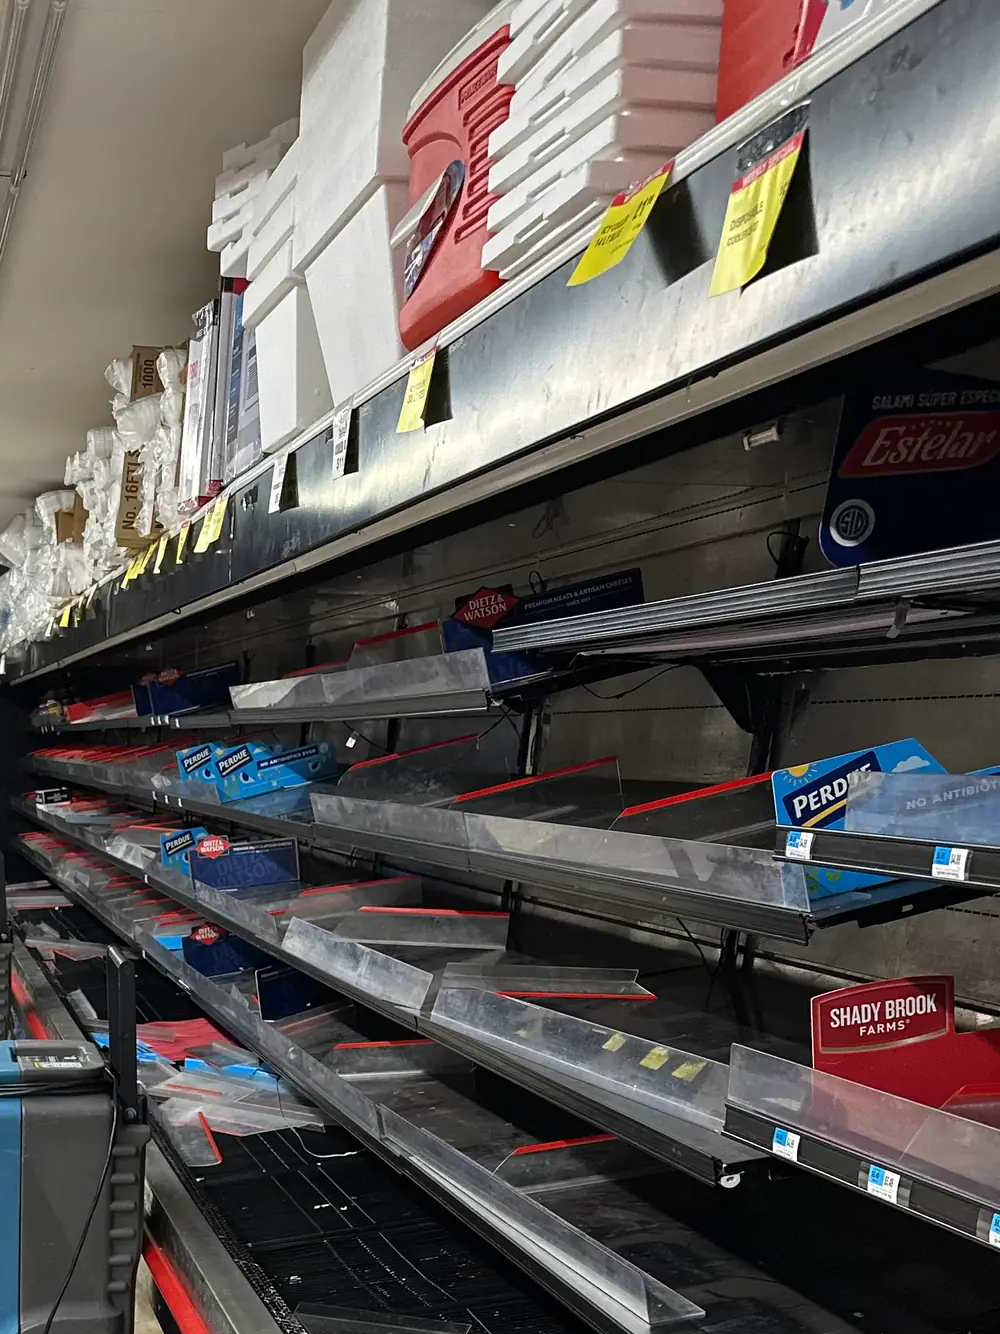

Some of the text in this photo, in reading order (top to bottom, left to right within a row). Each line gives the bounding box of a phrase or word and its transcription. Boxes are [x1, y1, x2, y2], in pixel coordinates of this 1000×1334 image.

[141, 359, 155, 389] 1000
[872, 394, 914, 411] SALAMI
[862, 420, 998, 467] Estelar
[121, 506, 136, 531] No.
[838, 508, 868, 537] SID
[468, 593, 505, 611] DIETZ &
[524, 597, 554, 611] PREMIUM
[553, 591, 573, 602] MEATS
[579, 584, 605, 596] ARTISAN
[605, 577, 633, 590] CHEESES
[463, 602, 508, 622] WATSON
[183, 748, 210, 768] PERDUE
[218, 749, 249, 772] PERDUE
[793, 762, 872, 819] PERDUE
[905, 798, 927, 810] NO
[165, 833, 191, 851] PERDUE
[829, 992, 938, 1029] SHADY BROOK
[859, 1019, 906, 1037] FARMS
